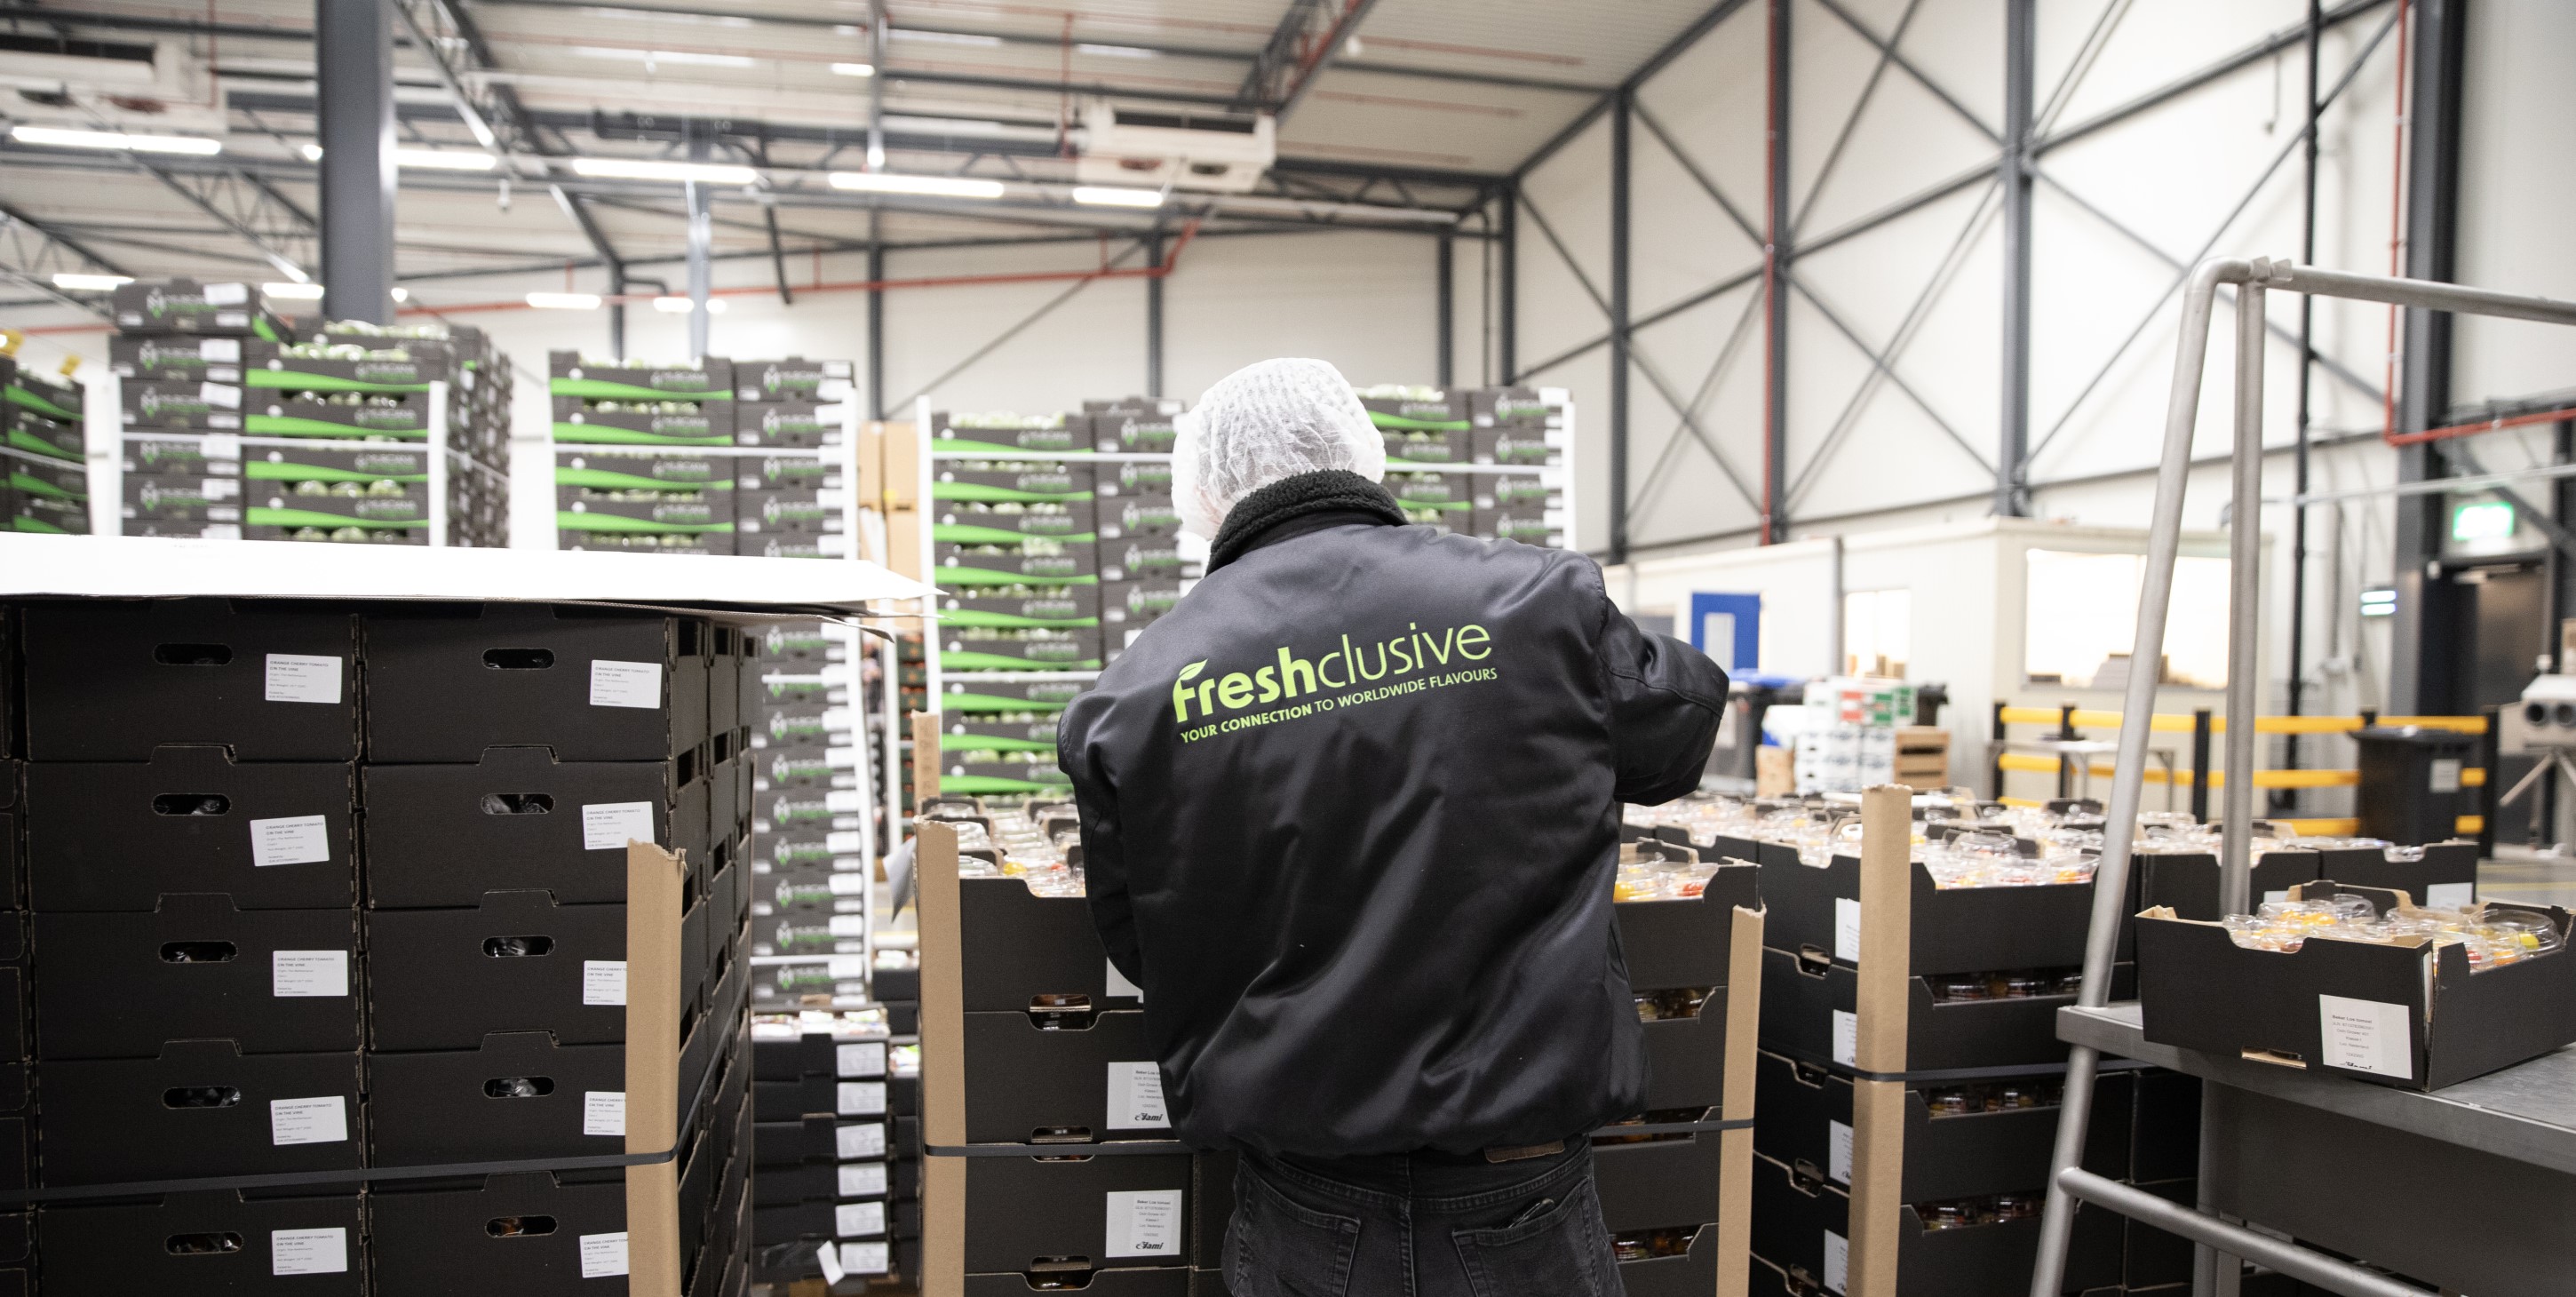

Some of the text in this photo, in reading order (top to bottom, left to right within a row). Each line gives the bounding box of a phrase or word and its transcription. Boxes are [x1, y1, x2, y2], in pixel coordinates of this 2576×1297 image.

[1181, 667, 1498, 744] YOUR CONNECTION TO WORLDWIDE FLAVOURS
